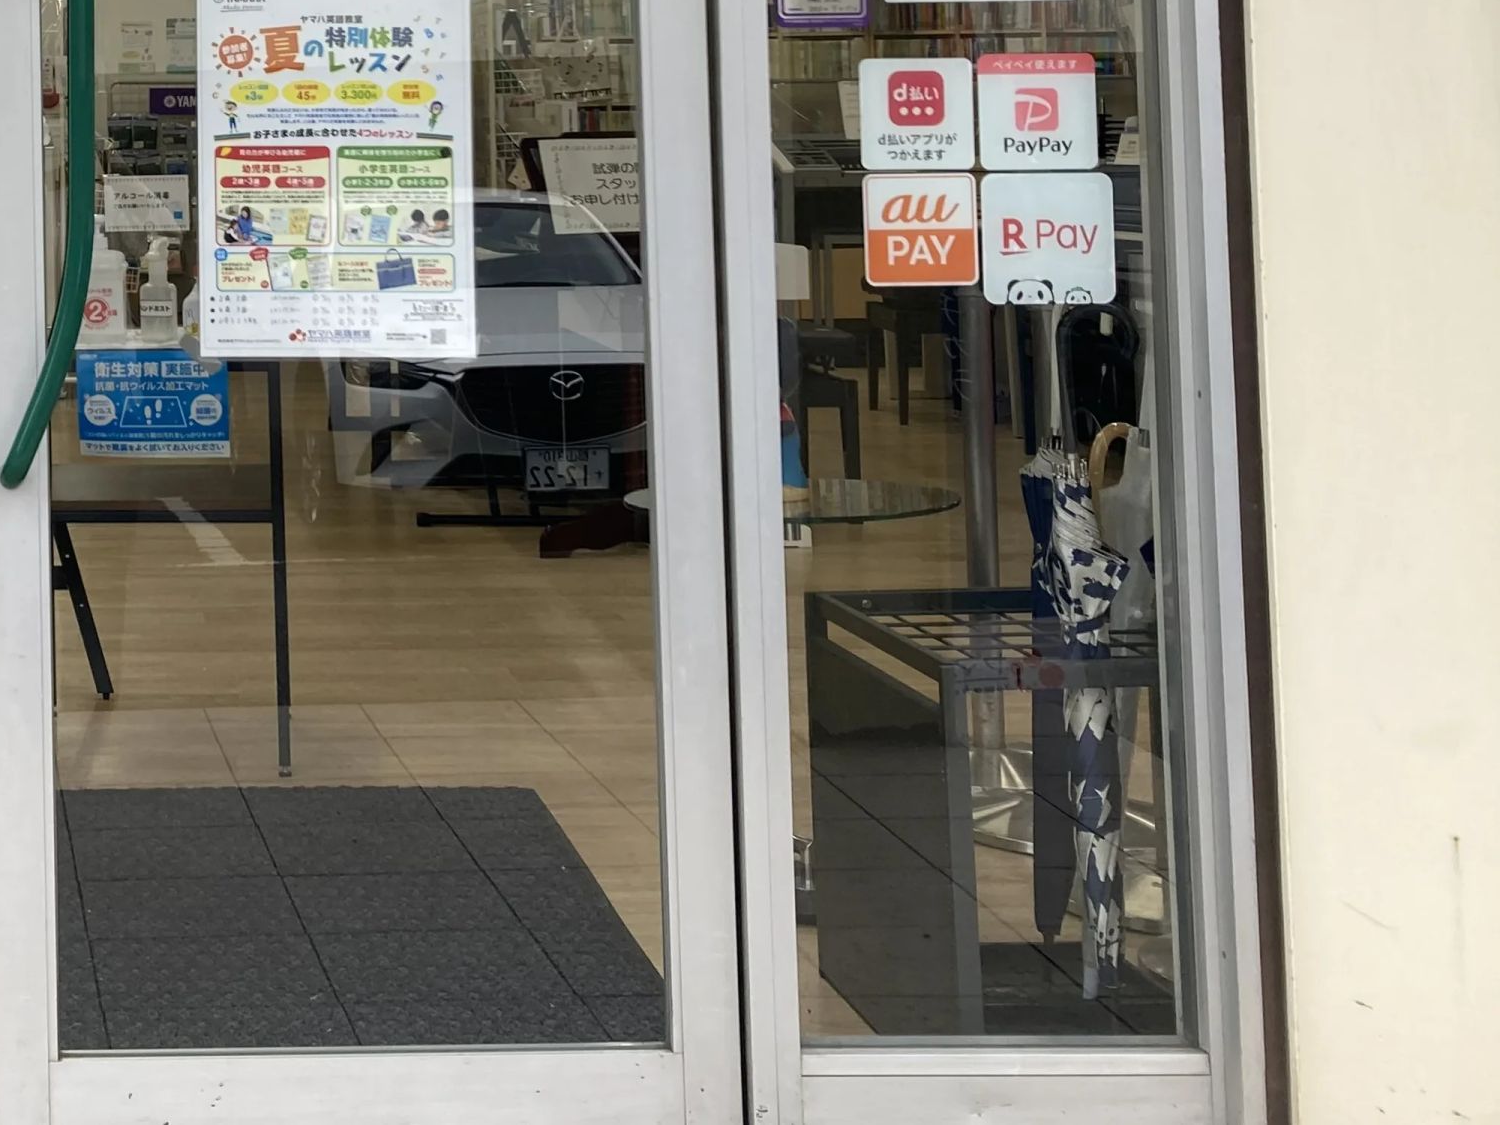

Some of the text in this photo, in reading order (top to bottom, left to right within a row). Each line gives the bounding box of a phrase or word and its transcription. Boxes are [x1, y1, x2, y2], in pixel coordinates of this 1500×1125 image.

[299, 15, 363, 25] ヤマハ英語教室
[325, 26, 414, 49] 特別体験
[327, 50, 412, 74] レッスン
[992, 59, 1078, 70] ペイペイ使えます
[892, 82, 940, 102] d払い
[253, 128, 414, 140] お子さまの成長に合わせた4つのレッスン
[878, 132, 958, 146] d払いアプリが
[1003, 136, 1073, 157] PayPay
[886, 148, 947, 161] つかえます
[241, 164, 304, 174] 幼児英語コース
[358, 164, 432, 174] 小学生英語コース
[592, 162, 639, 175] 試弾の
[113, 191, 170, 200] アルコール消毒
[880, 193, 960, 223] au
[1036, 219, 1099, 254] Pay
[886, 235, 956, 266] PAY
[94, 361, 159, 378] 衛生対策
